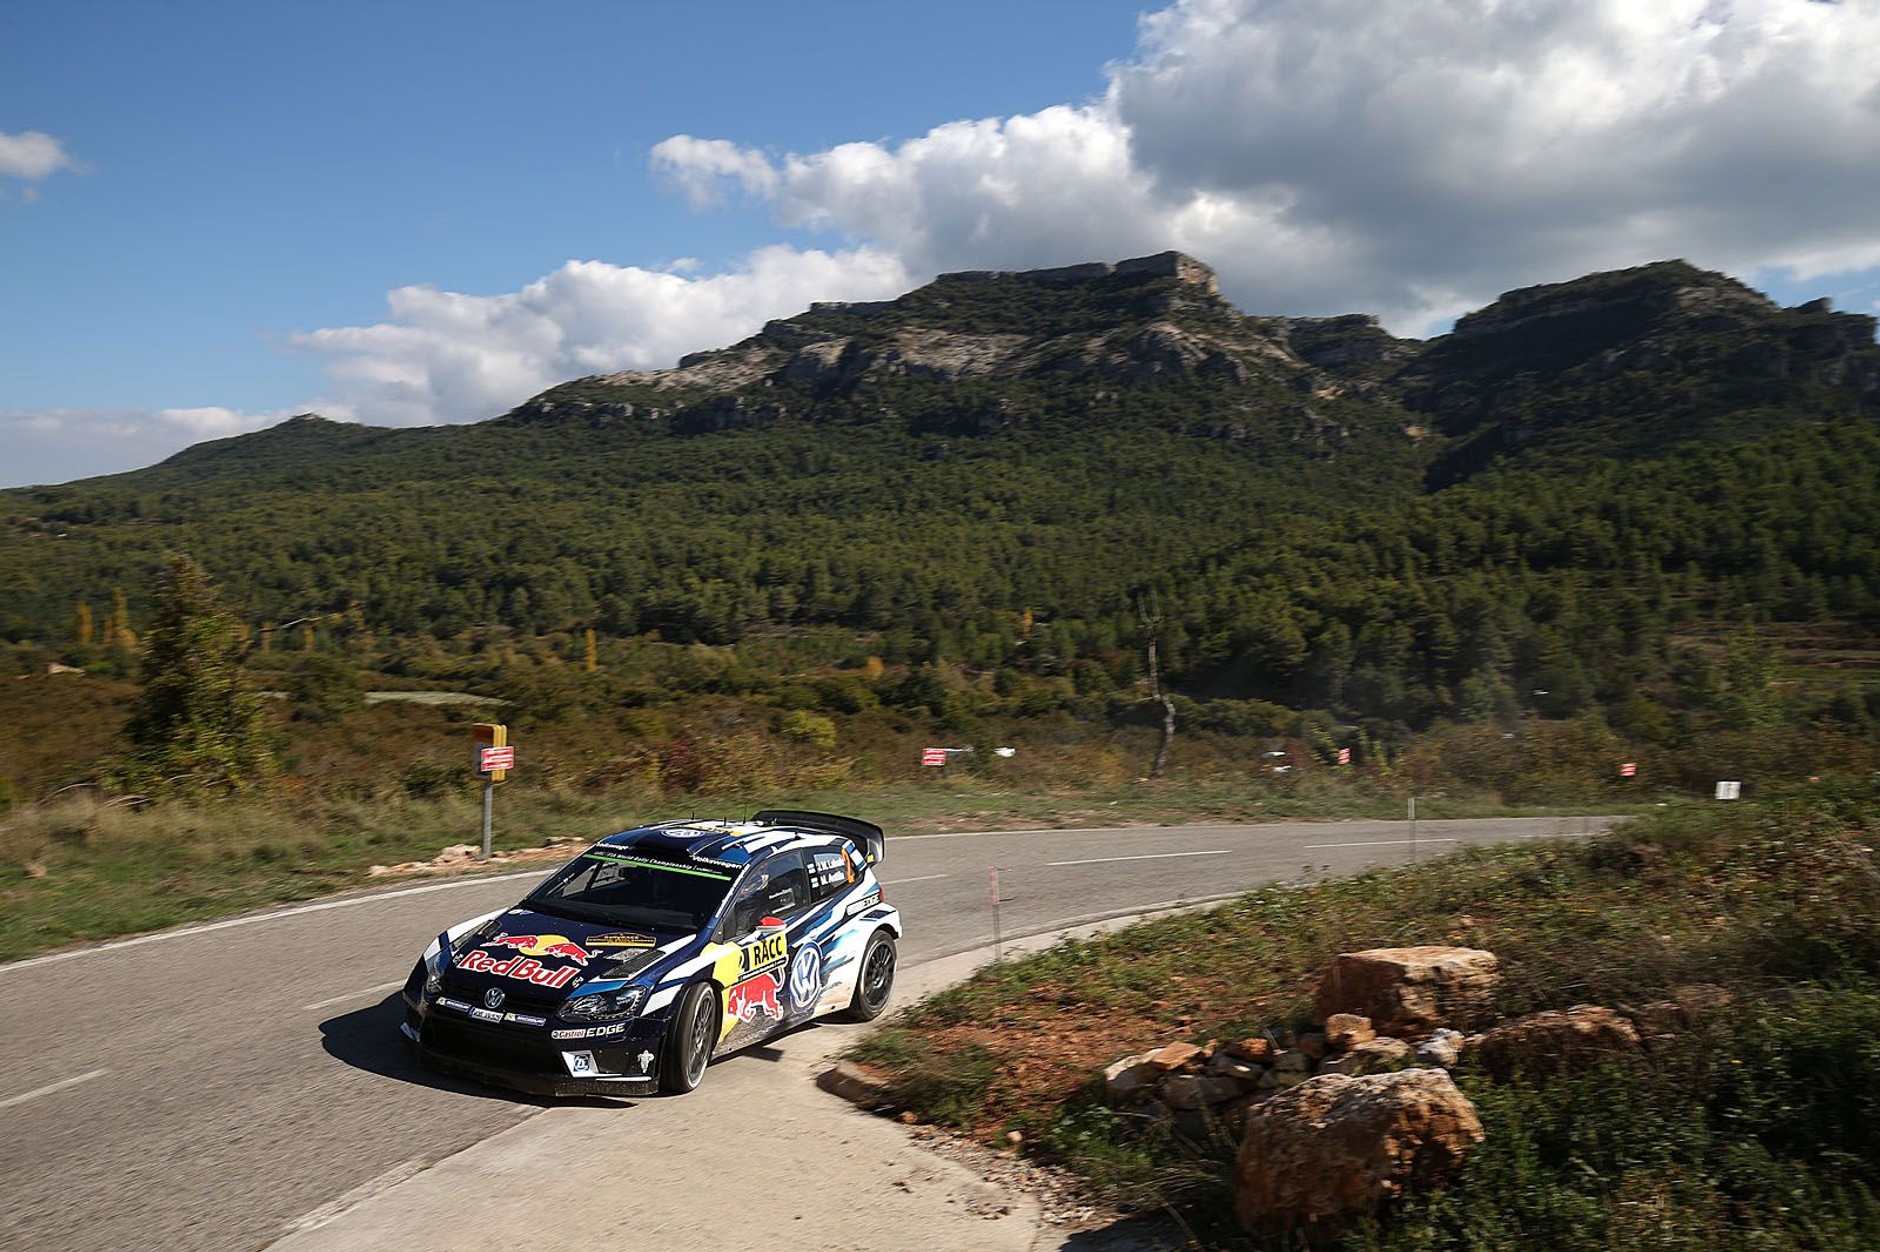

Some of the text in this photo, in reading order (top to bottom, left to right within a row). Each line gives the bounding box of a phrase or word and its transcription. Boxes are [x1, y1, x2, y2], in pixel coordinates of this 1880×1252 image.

[634, 856, 649, 864] Rally
[650, 858, 692, 870] Championship
[692, 855, 743, 870] Volkswagen
[841, 848, 855, 884] 2
[753, 936, 783, 966] RACC
[457, 950, 580, 988] Red Bull
[560, 1022, 626, 1038] Castrol EDGE
